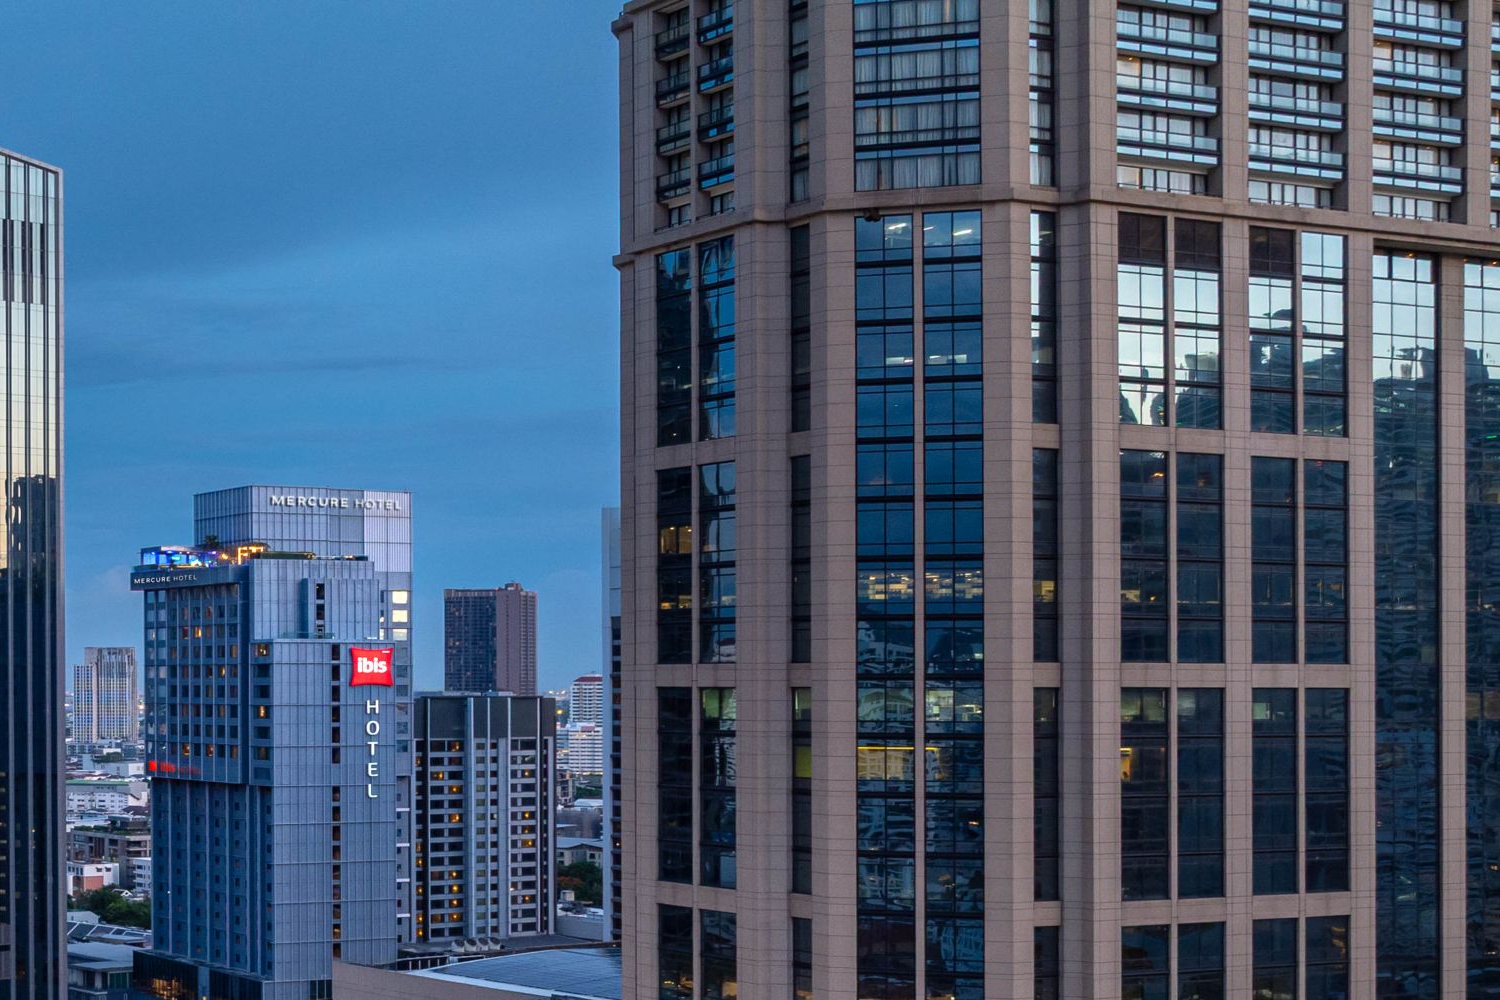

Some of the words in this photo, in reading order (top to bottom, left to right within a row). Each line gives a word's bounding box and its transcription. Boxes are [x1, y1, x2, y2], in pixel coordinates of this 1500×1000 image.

[270, 495, 349, 509] MERCURE
[354, 499, 402, 512] HOTEL
[133, 575, 171, 584] MERCURE
[173, 573, 198, 582] HOTEL
[357, 657, 387, 673] ibis
[366, 699, 380, 798] HOTEL
